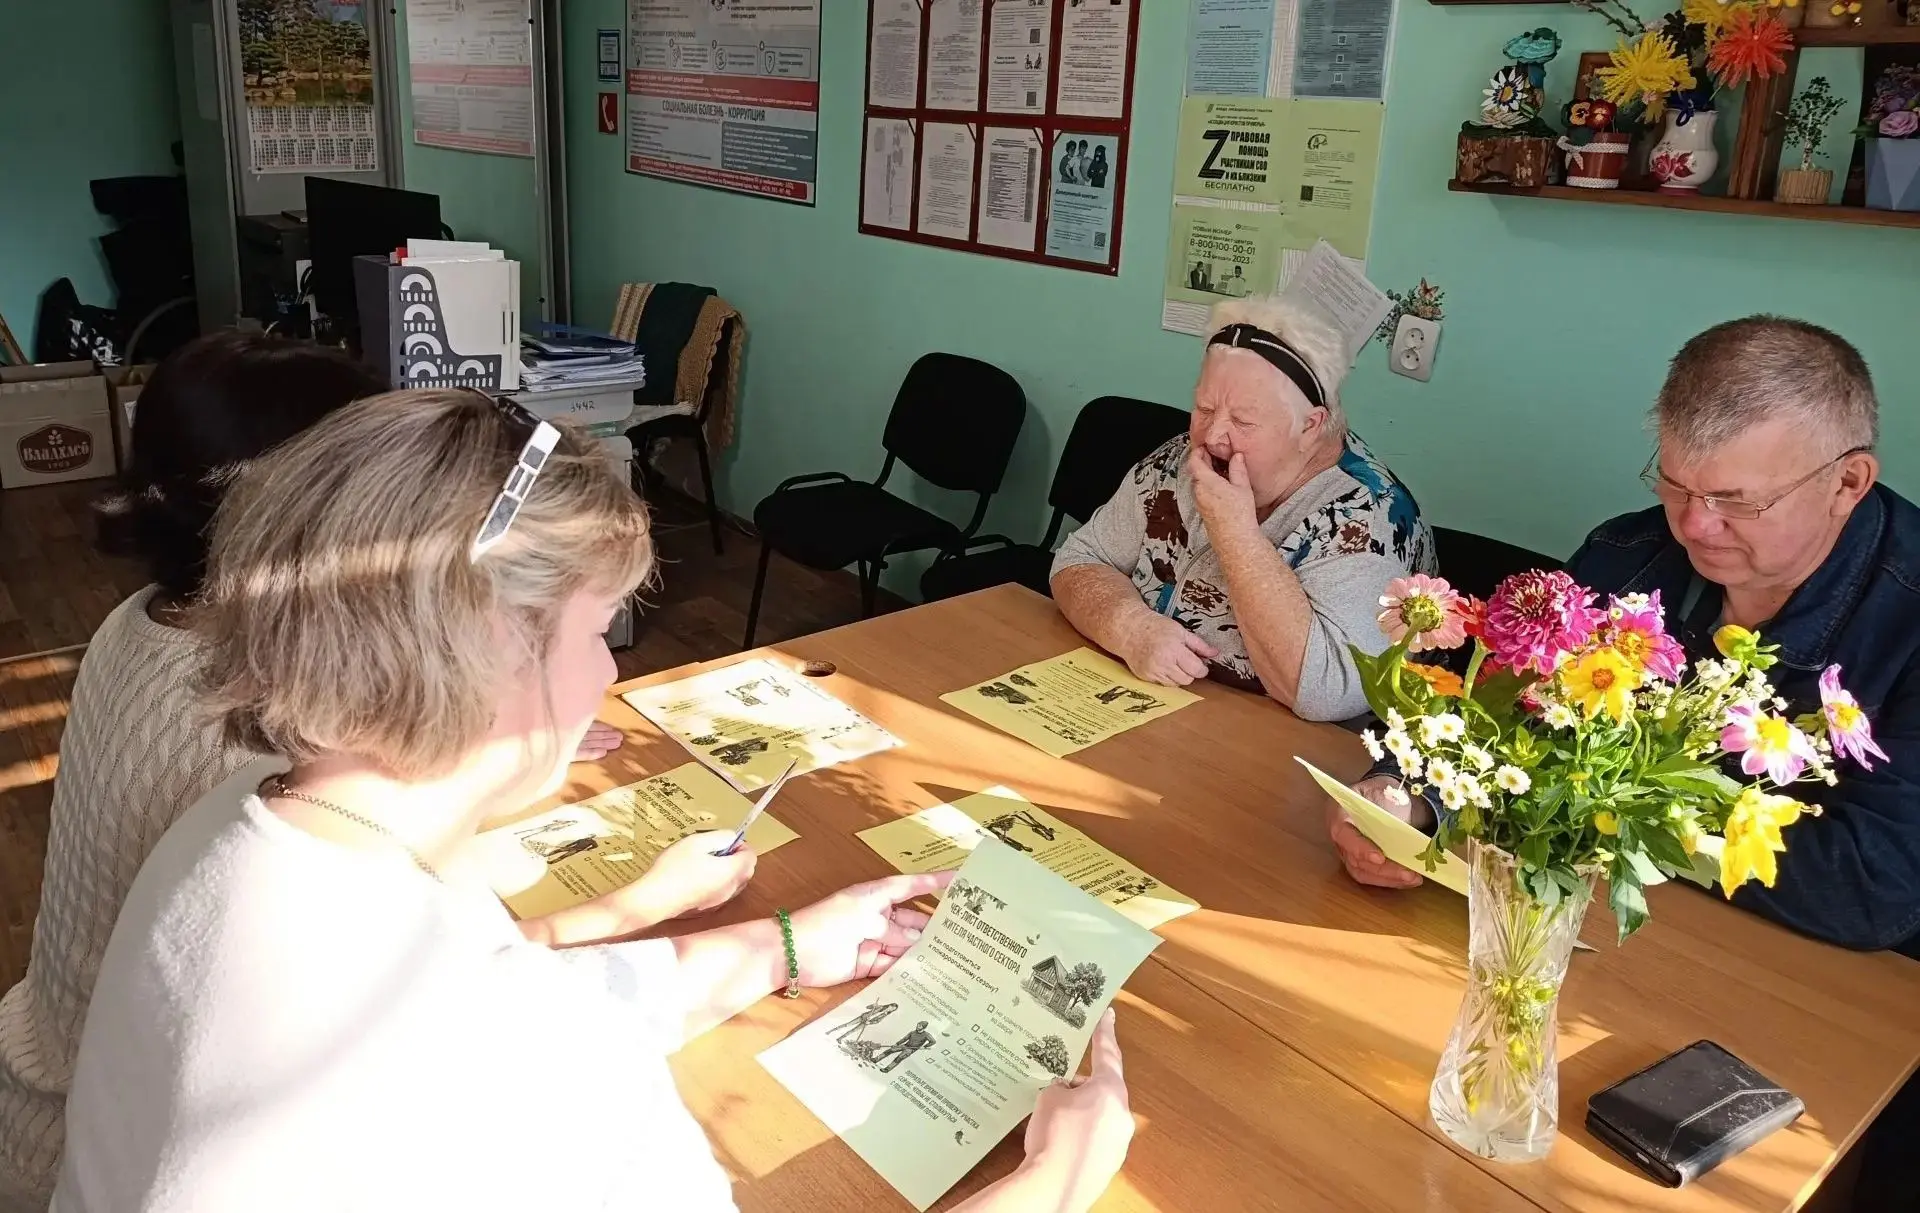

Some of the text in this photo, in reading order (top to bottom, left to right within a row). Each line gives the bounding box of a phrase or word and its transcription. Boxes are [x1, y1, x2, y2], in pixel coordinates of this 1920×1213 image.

[662, 99, 698, 114] СОЦИАЛЬНАЯ
[698, 104, 724, 118] БОЛЕЗНЬ
[728, 107, 766, 122] КОРРУПЦИЯ
[1230, 131, 1270, 144] ПРАВОВАЯ
[1198, 129, 1231, 179] Z
[1238, 145, 1268, 158] ПОМОЩЬ
[1205, 181, 1255, 193] БЕСПЛАТНО
[1190, 238, 1256, 255] 8-800-100-00-01
[1202, 250, 1212, 259] 23
[1232, 255, 1250, 265] 2023
[951, 902, 1028, 958] ЧЕК-ЛИСТ ОТВЕТСТВЕННОГО
[942, 917, 1021, 975] ЖИТЕЛЯ ЧАСТНОГО СЕКТОРА
[942, 942, 982, 971] подготовиться
[931, 946, 977, 980] пожароопасному
[975, 976, 1000, 994] сезону?
